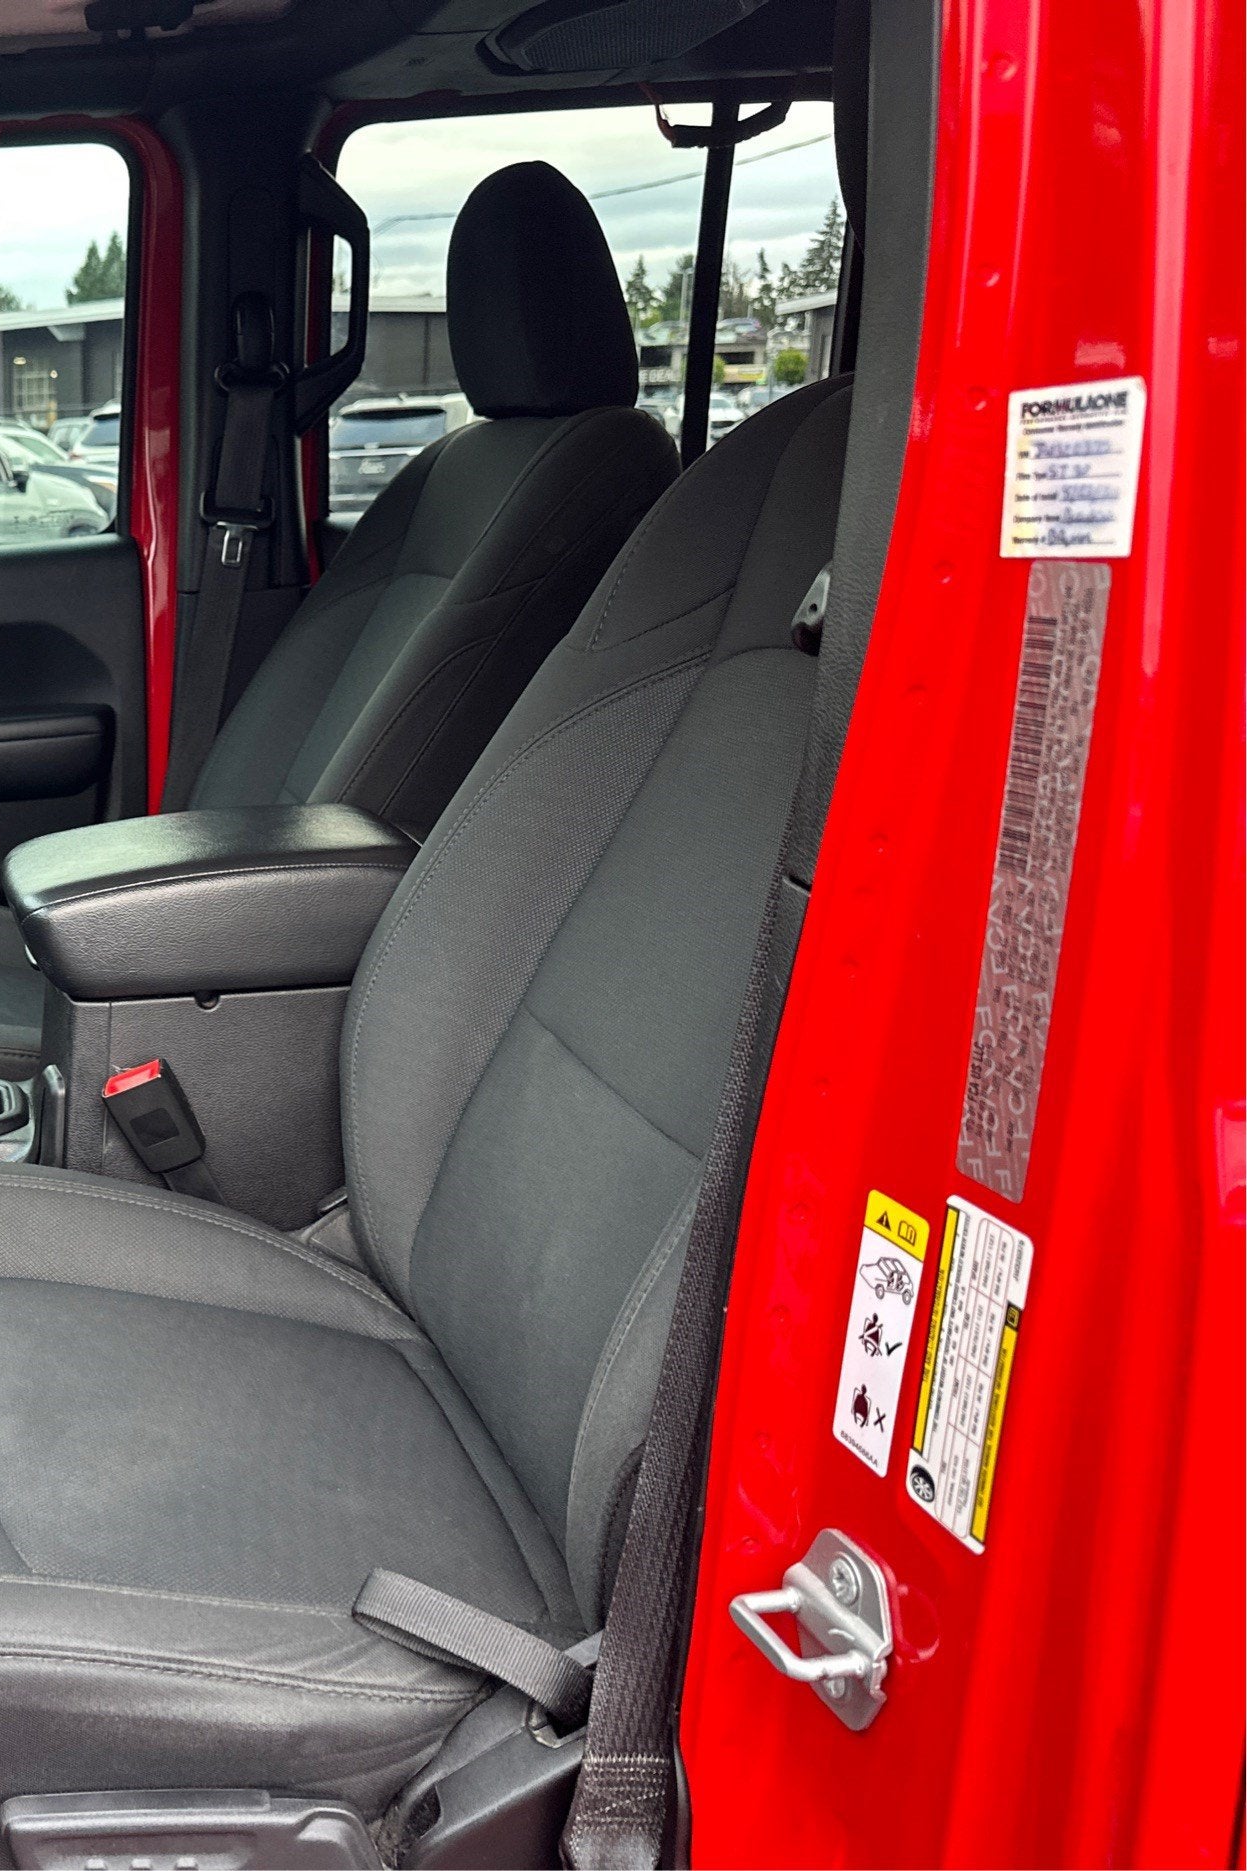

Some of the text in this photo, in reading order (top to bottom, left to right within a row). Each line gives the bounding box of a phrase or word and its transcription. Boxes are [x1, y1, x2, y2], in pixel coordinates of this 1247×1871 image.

[973, 1041, 984, 1062] LLC
[971, 1063, 982, 1080] US
[968, 1082, 979, 1102] FCA
